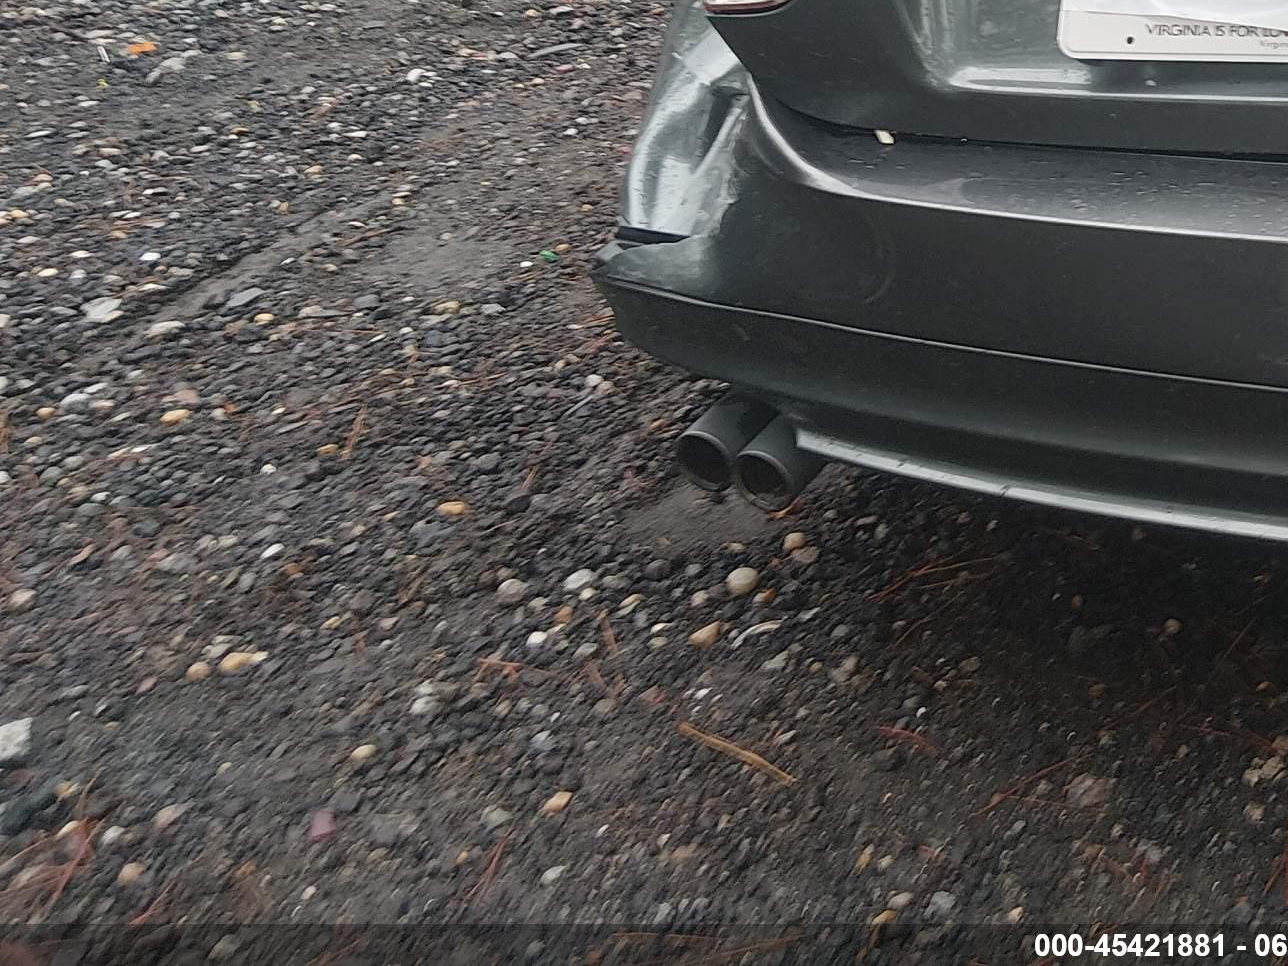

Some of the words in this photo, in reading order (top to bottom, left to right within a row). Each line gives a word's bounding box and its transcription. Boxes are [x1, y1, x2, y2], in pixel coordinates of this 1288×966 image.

[1145, 23, 1212, 37] VIRGINIA
[1215, 24, 1226, 38] IS
[1230, 24, 1259, 38] FOR
